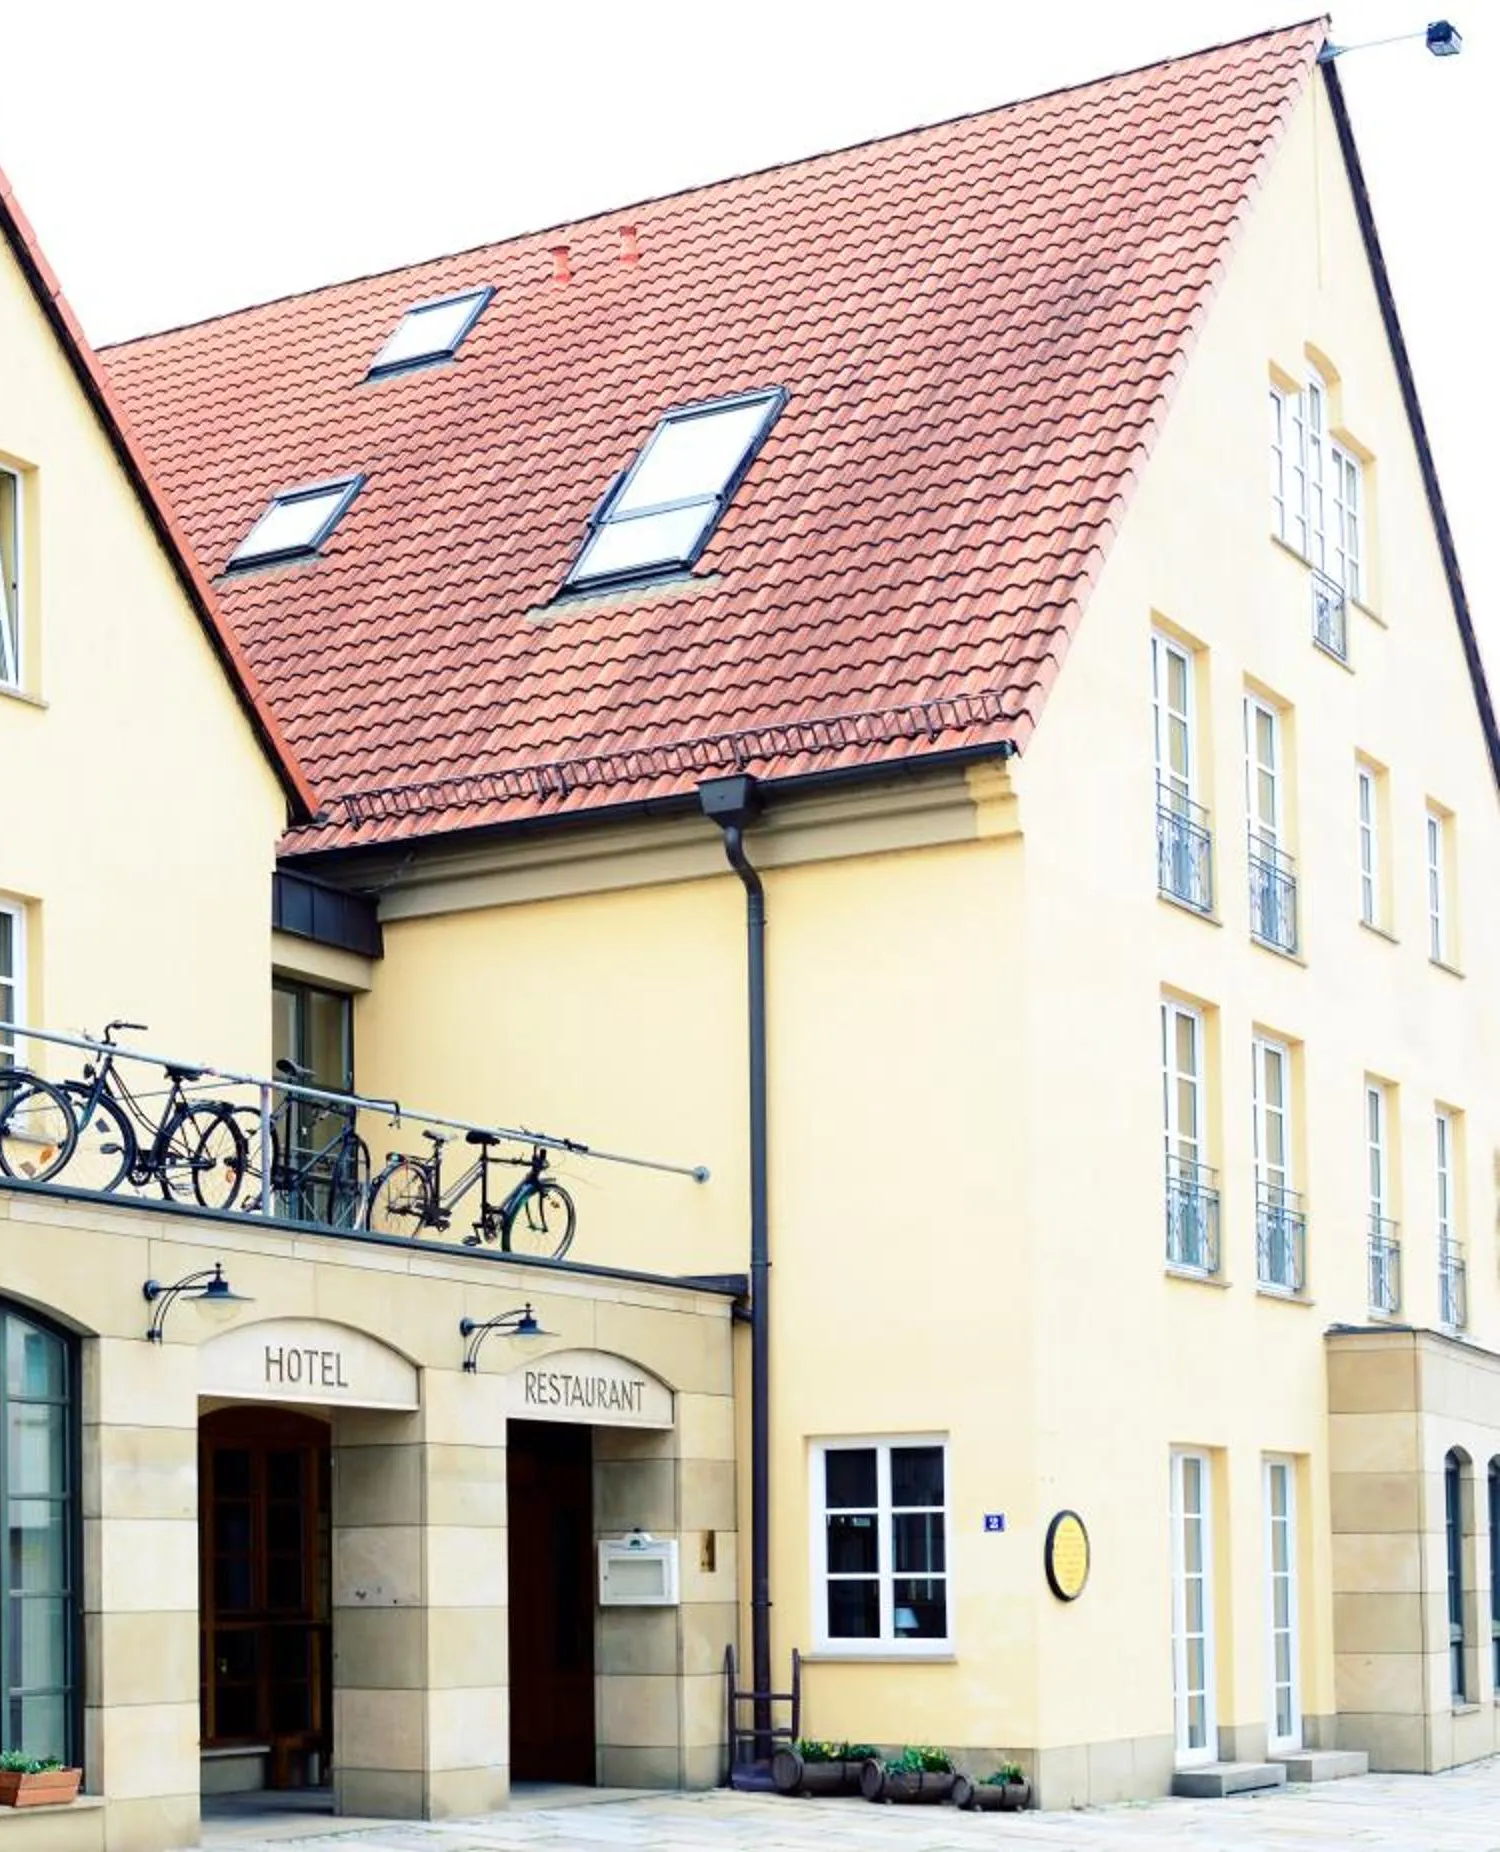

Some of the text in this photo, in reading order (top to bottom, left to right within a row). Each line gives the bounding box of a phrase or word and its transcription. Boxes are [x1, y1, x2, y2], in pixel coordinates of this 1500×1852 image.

[265, 1346, 348, 1388] HOTEL
[525, 1371, 645, 1412] RESTAURANT
[988, 1517, 999, 1529] 2
